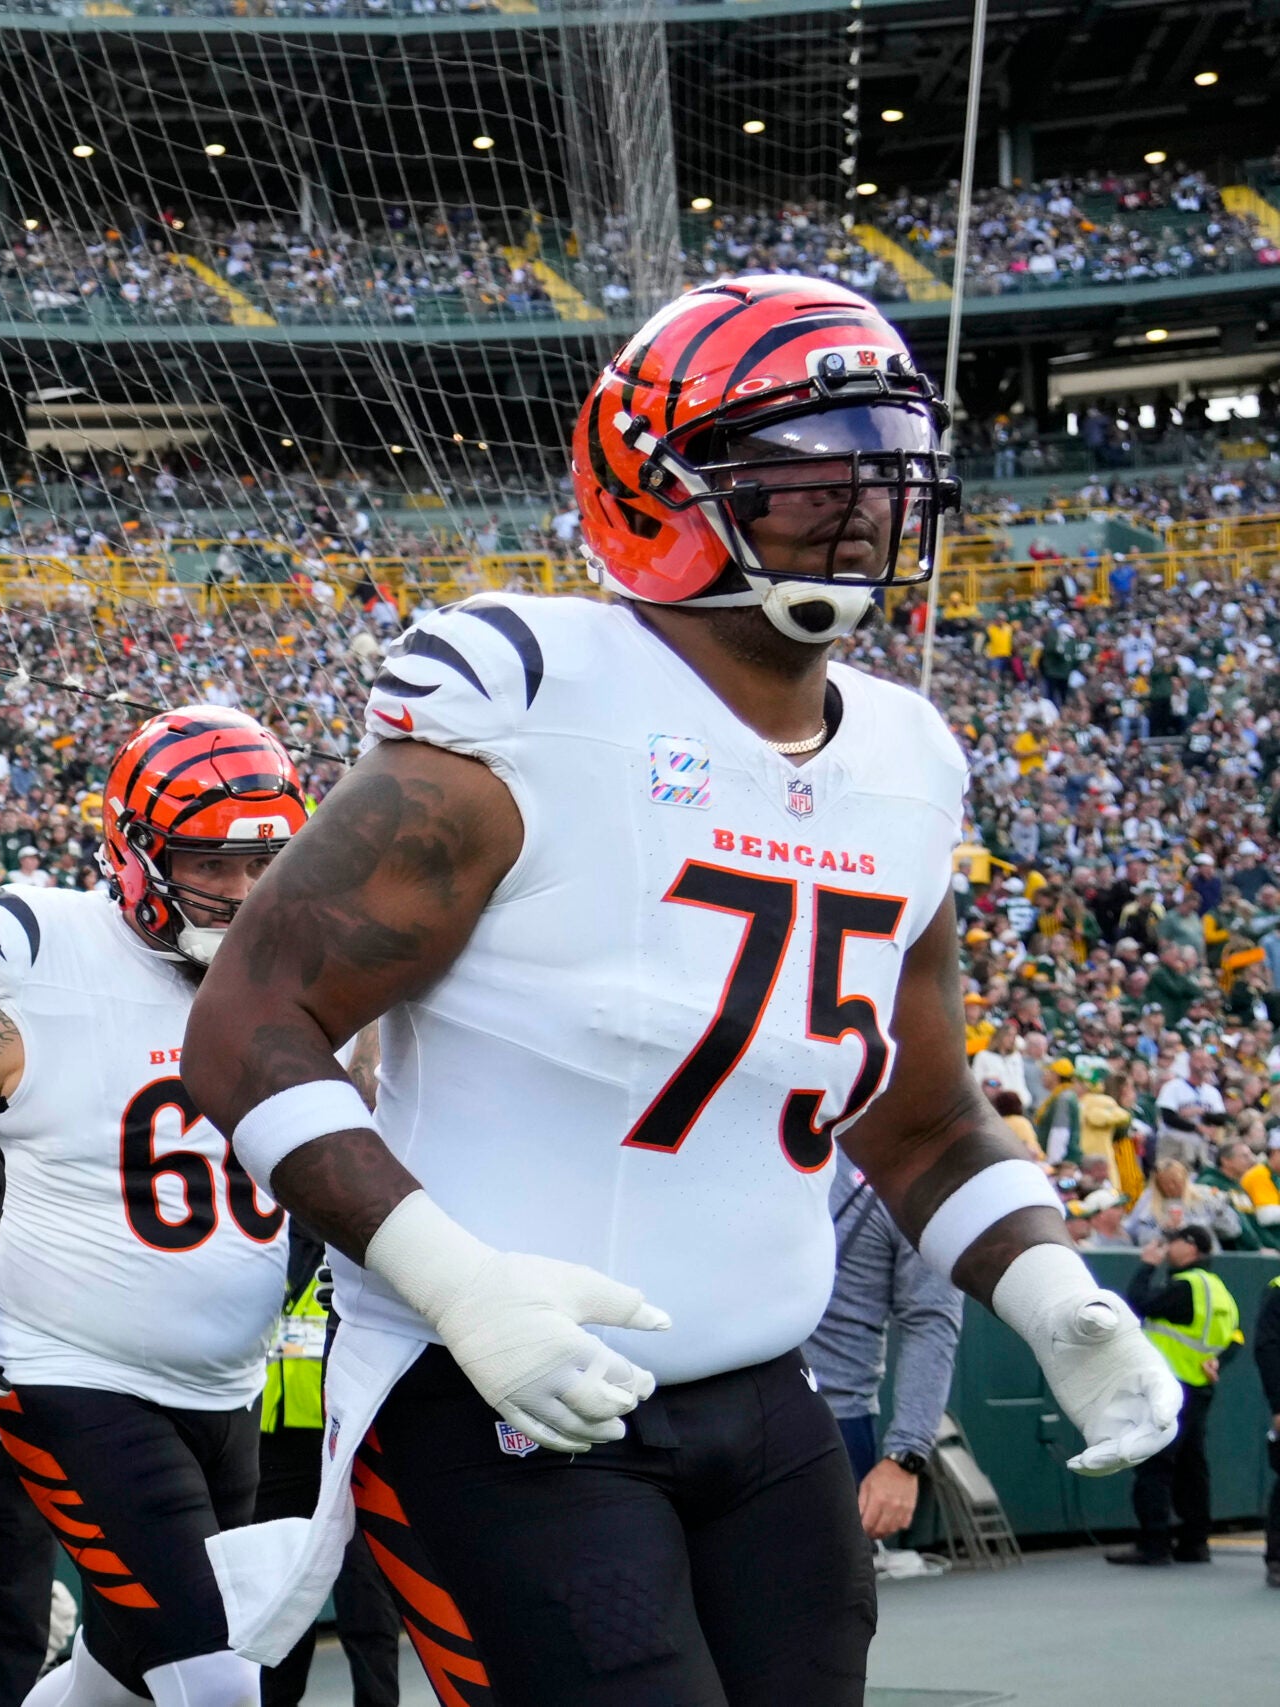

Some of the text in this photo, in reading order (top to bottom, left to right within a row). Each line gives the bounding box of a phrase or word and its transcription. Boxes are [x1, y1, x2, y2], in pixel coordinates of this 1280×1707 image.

[791, 794, 811, 811] NFL
[712, 828, 875, 875] BENGALS
[621, 858, 907, 1173] 75
[505, 1433, 532, 1450] NFL
